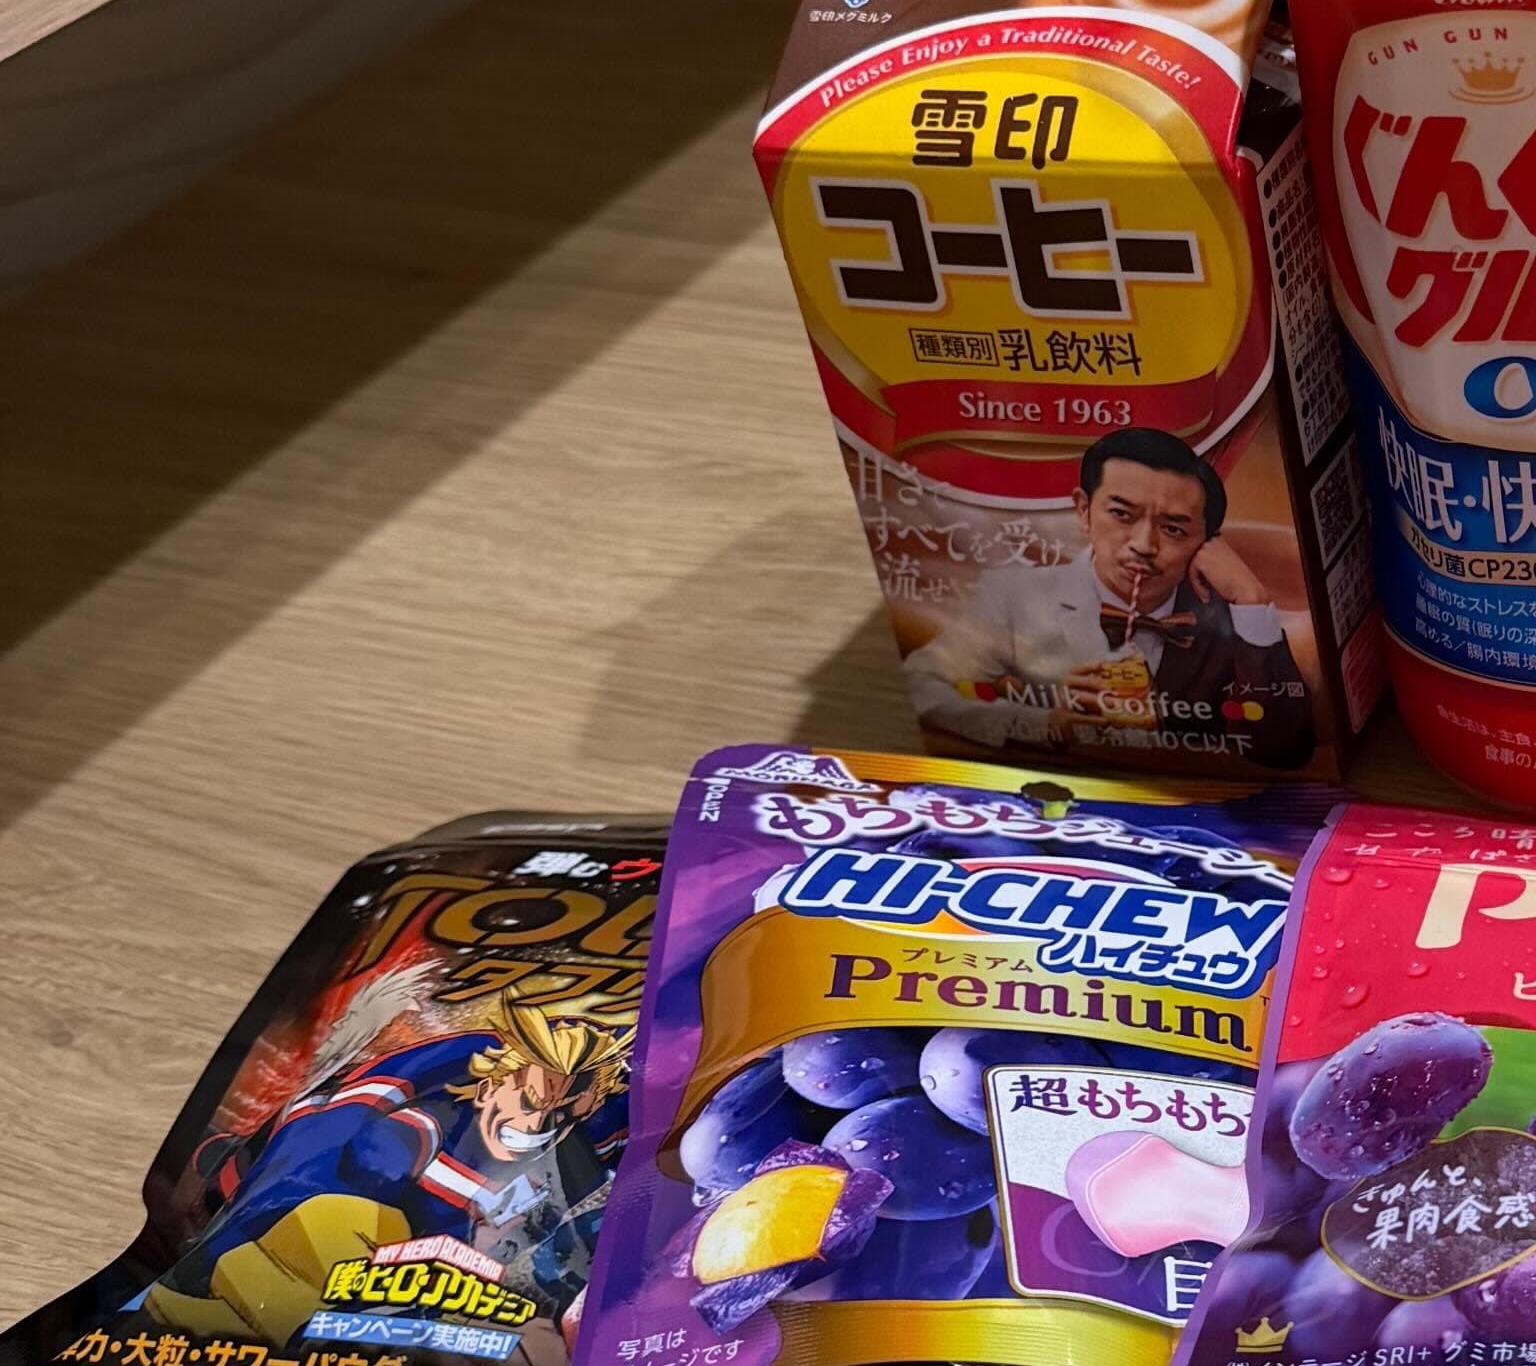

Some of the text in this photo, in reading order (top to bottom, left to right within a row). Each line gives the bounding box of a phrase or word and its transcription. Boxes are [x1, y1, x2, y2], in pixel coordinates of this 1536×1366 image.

[808, 9, 893, 24] 雪印メグミルク
[819, 25, 1202, 107] Please Enjoy a Traditional Taste!
[1367, 39, 1418, 66] GUN
[1443, 27, 1509, 44] GUN
[910, 88, 1079, 171] 雪印
[814, 178, 1200, 317] コーヒー
[916, 329, 1142, 376] 種類別 乳飲料
[958, 391, 1131, 427] Since 1963
[869, 504, 1060, 571] すべてを受け
[1004, 682, 1213, 721] Milk Coffee
[721, 765, 881, 793] MORINAGA
[795, 850, 1288, 944] HI-CHEW
[902, 946, 1033, 973] プレミアム
[1047, 932, 1248, 985] ハイチュウ
[824, 952, 1253, 1053] Premium
[1009, 1073, 1250, 1137] 超もちもち
[1352, 1163, 1484, 1215] きゅんと、
[1366, 1193, 1536, 1251] 果肉食感
[377, 1243, 401, 1263] MY
[403, 1236, 440, 1260] HERO
[310, 1312, 513, 1359] キャンペーン実施中!
[616, 1328, 686, 1361] 写真は
